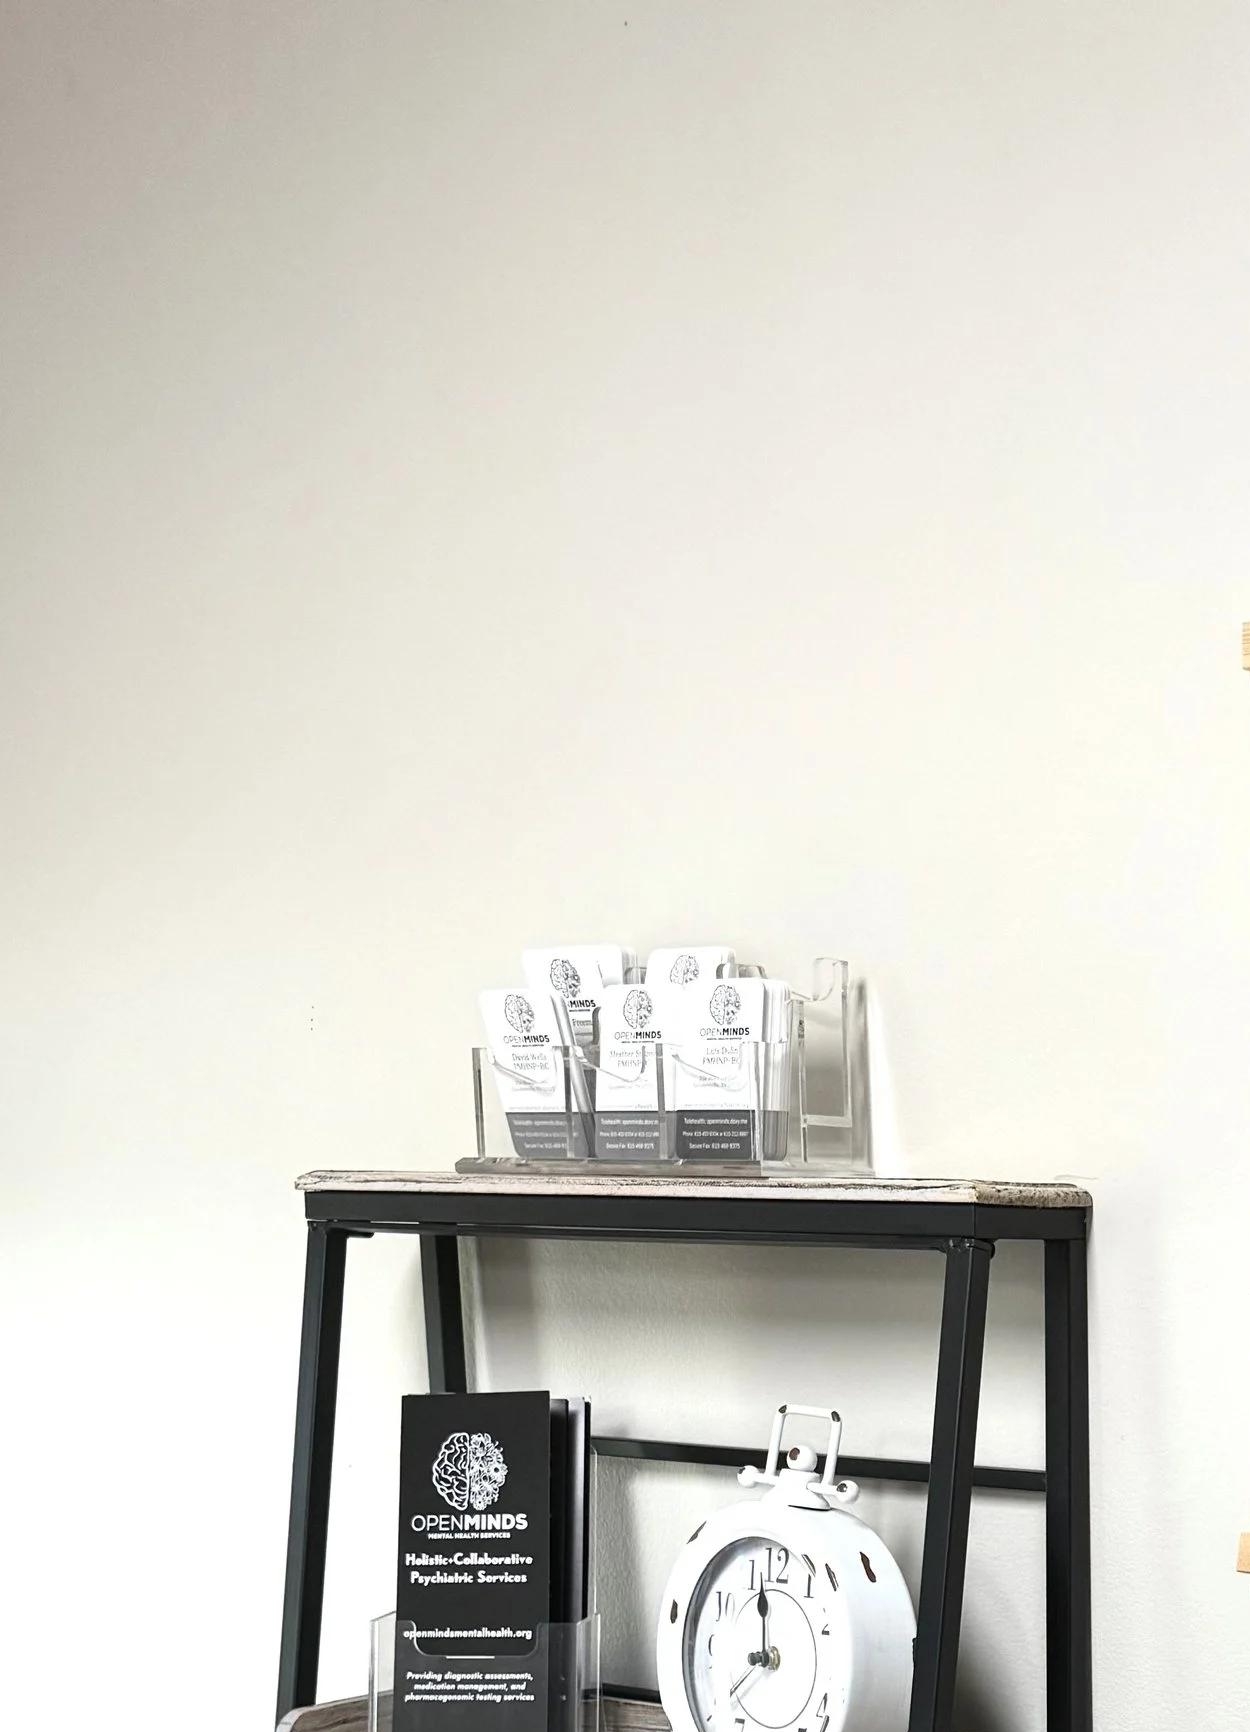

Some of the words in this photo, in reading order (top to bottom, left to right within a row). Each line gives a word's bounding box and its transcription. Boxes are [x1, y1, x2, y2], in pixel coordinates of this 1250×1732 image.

[615, 1031, 662, 1040] OPENMINDS
[700, 1027, 750, 1036] OPENMINDS
[504, 1035, 550, 1043] OPENMINDS
[411, 1513, 528, 1531] OPENMINDS
[765, 1548, 789, 1584] 12
[411, 1571, 473, 1586] Psychiatric
[478, 1570, 527, 1583] Services
[403, 1627, 532, 1640] openmindsmentalhealth.org
[406, 1671, 442, 1681] Providing
[444, 1671, 483, 1681] diagnostic
[414, 1682, 455, 1690] medication
[510, 1682, 526, 1690] and
[476, 1693, 502, 1703] testing
[504, 1693, 534, 1701] services
